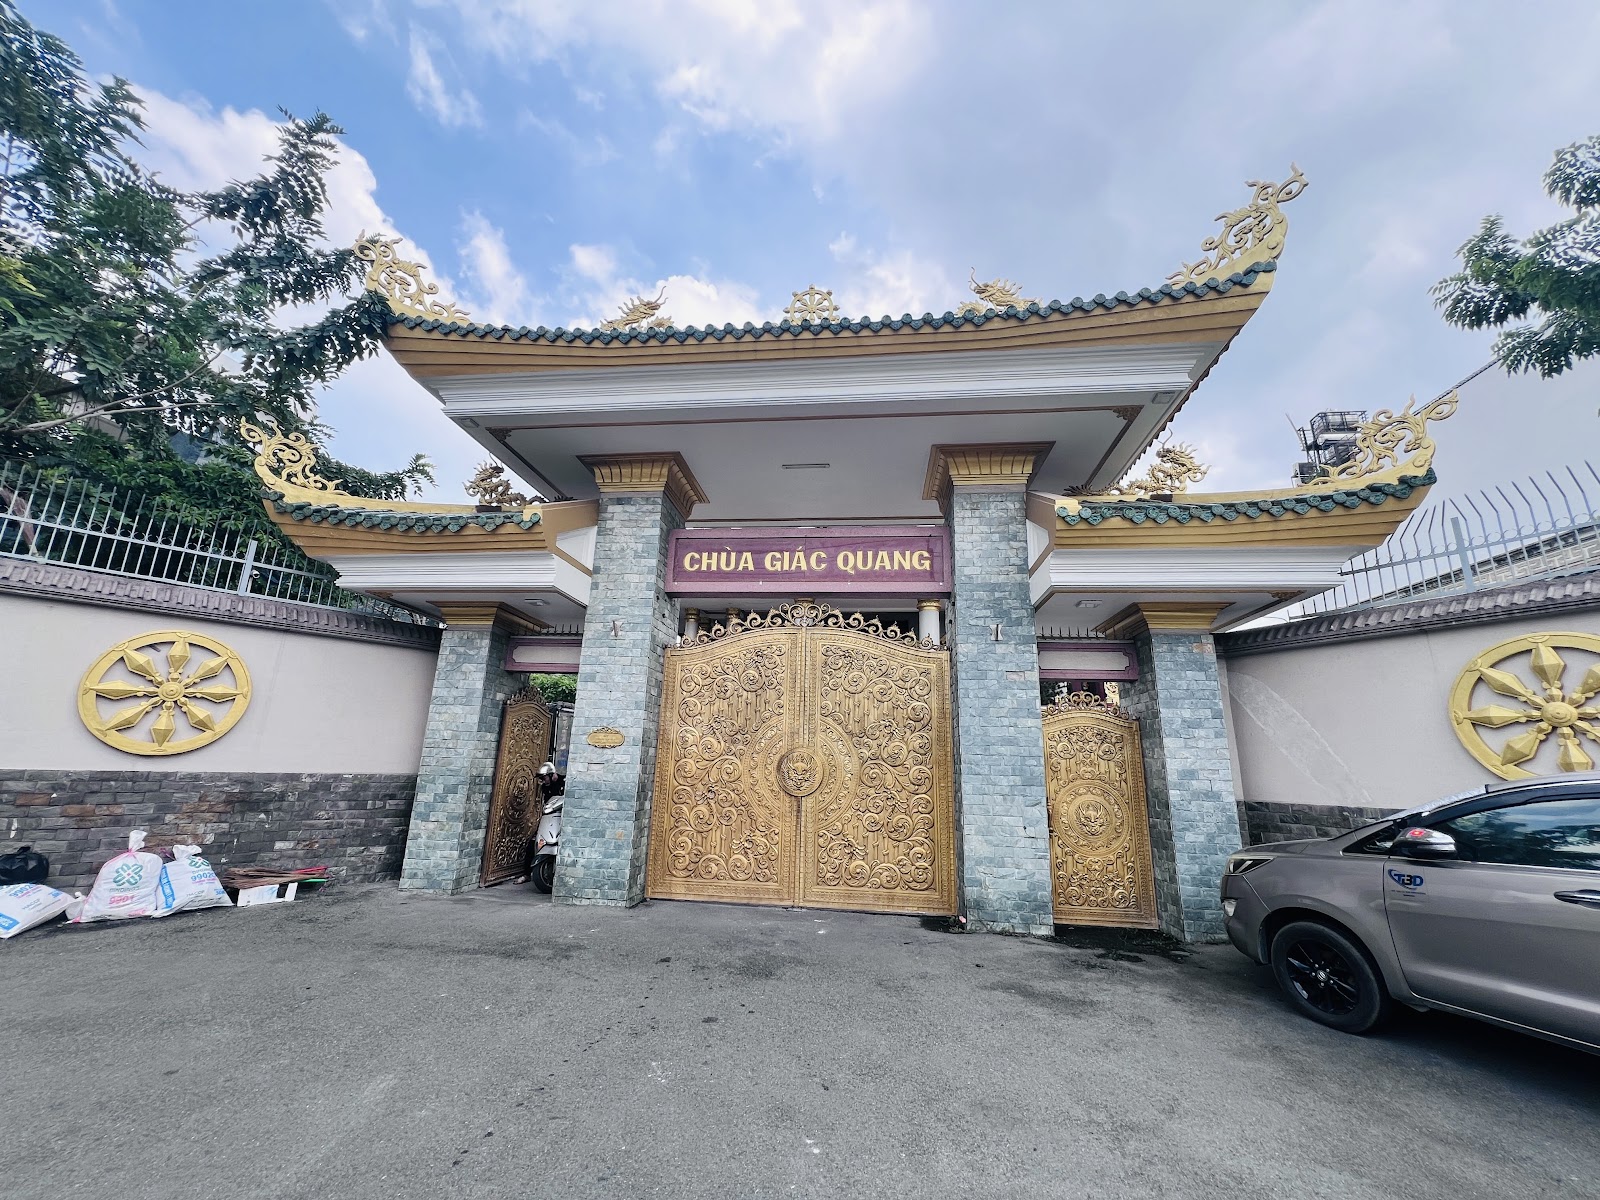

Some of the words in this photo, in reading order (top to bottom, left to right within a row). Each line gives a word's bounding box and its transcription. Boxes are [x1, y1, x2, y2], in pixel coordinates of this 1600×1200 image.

[683, 546, 755, 572] CHÙA
[764, 546, 828, 572] GIÁC
[836, 550, 931, 575] QUANG
